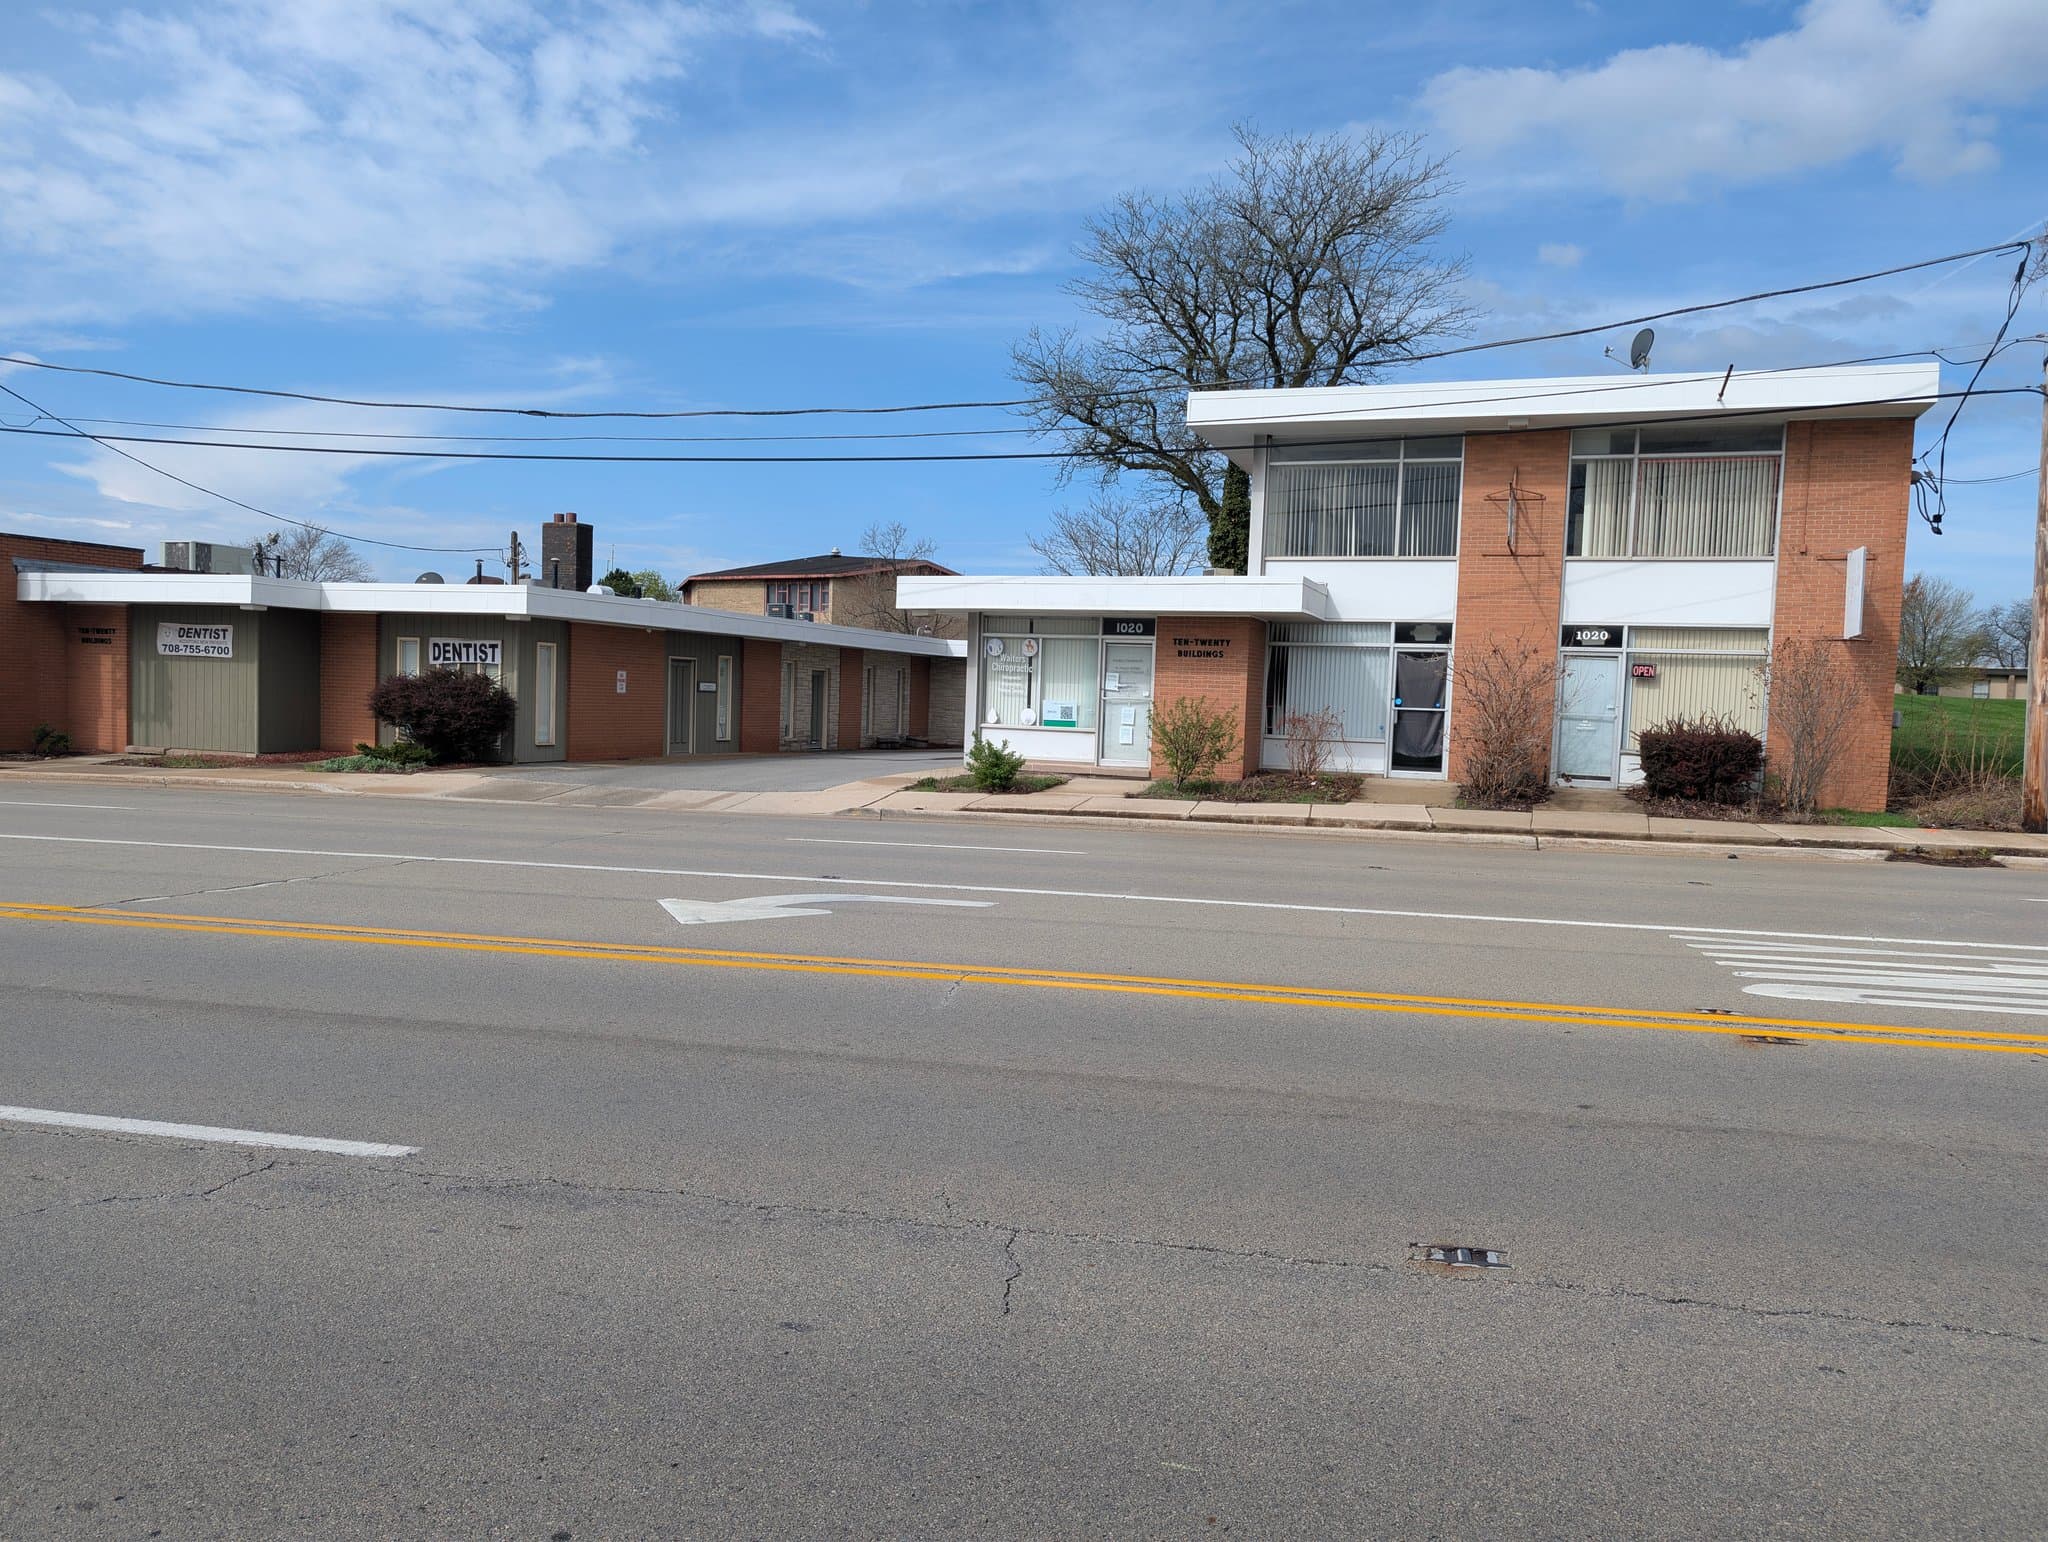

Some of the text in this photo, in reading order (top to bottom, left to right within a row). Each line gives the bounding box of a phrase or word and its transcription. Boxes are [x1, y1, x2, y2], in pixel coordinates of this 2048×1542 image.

[178, 627, 228, 640] DENTIST
[1116, 623, 1143, 633] 1020
[1576, 630, 1608, 640] 1020
[1173, 638, 1231, 647] TEN-TWENTY
[162, 643, 230, 655] 708-755-6700
[432, 642, 499, 662] DENTIST
[1177, 650, 1224, 658] BUILDINGS
[991, 662, 1034, 674] Chiropractic
[1633, 665, 1655, 676] OPEN
